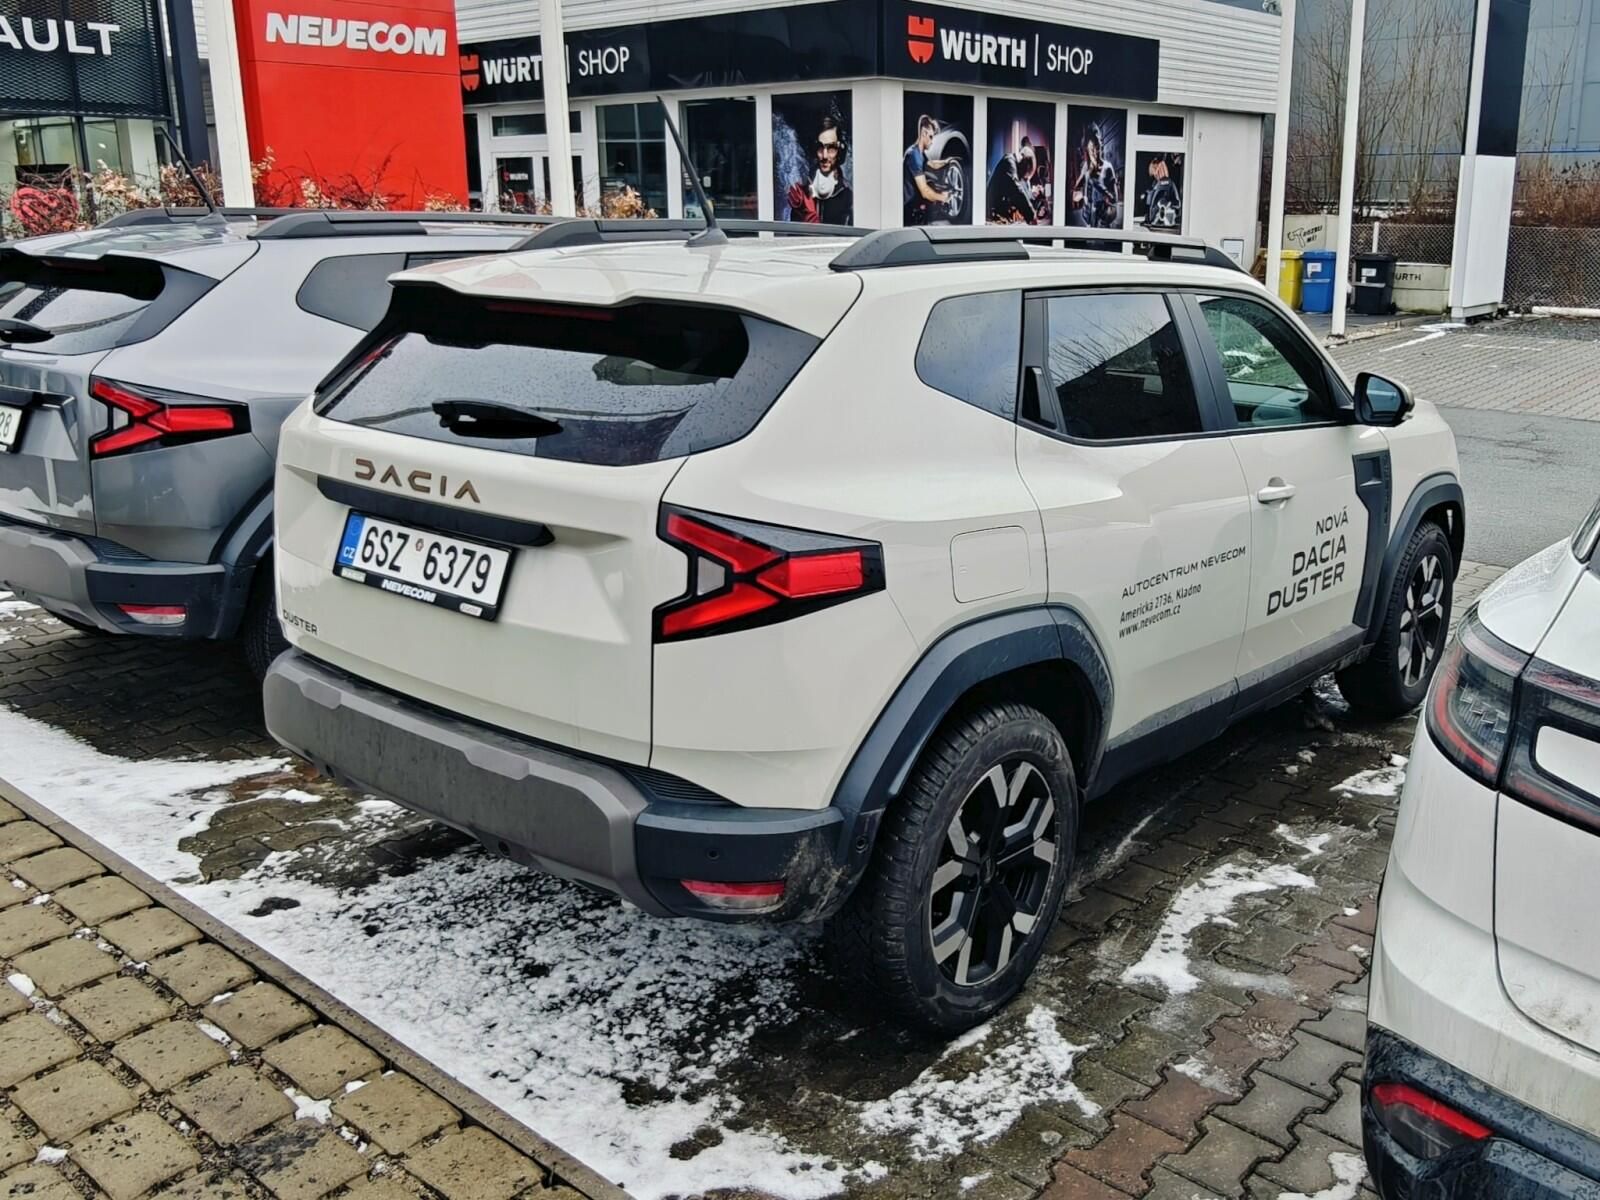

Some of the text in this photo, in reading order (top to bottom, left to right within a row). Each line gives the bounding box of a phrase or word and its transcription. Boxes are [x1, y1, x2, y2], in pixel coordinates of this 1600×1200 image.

[265, 12, 447, 57] NEVECOM
[939, 28, 1093, 75] WÜRTH SHOP
[482, 46, 630, 85] WÜRT SHOP
[1395, 272, 1422, 281] URTH
[355, 458, 481, 502] DACIA
[1315, 505, 1349, 537] NOVÁ
[343, 546, 356, 559] CZ
[361, 526, 493, 594] 6SZ 6379
[1292, 534, 1347, 577] DACIA
[381, 578, 437, 602] NEVECOM
[1121, 545, 1247, 600] AUTOCENTRUM NEVECOM
[1175, 583, 1202, 601] Kladno
[1266, 561, 1346, 617] DUSTER
[282, 608, 318, 636] DUSTER
[1119, 604, 1181, 638] www.nevecom.cz
